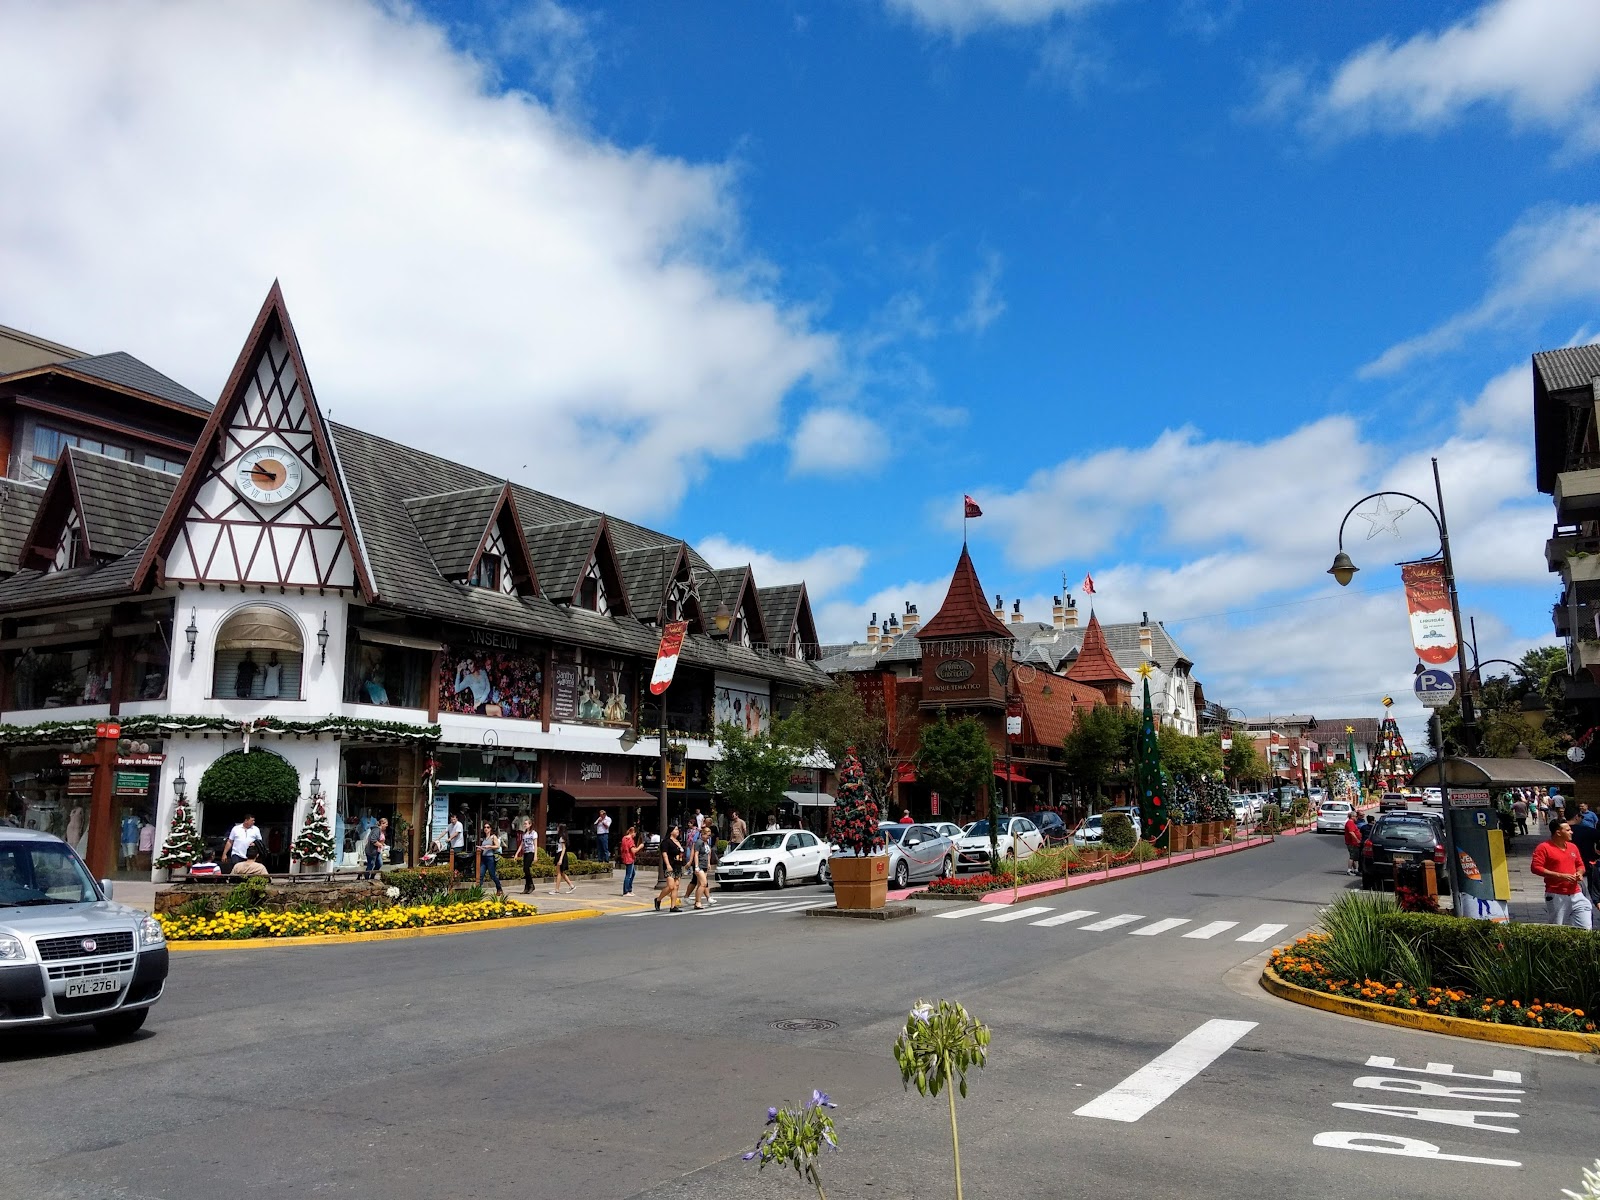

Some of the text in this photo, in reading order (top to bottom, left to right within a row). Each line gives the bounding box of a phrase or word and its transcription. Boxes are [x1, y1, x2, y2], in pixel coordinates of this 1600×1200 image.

[1420, 674, 1437, 690] P
[581, 762, 602, 773] Santho
[1303, 1055, 1527, 1167] PARE
